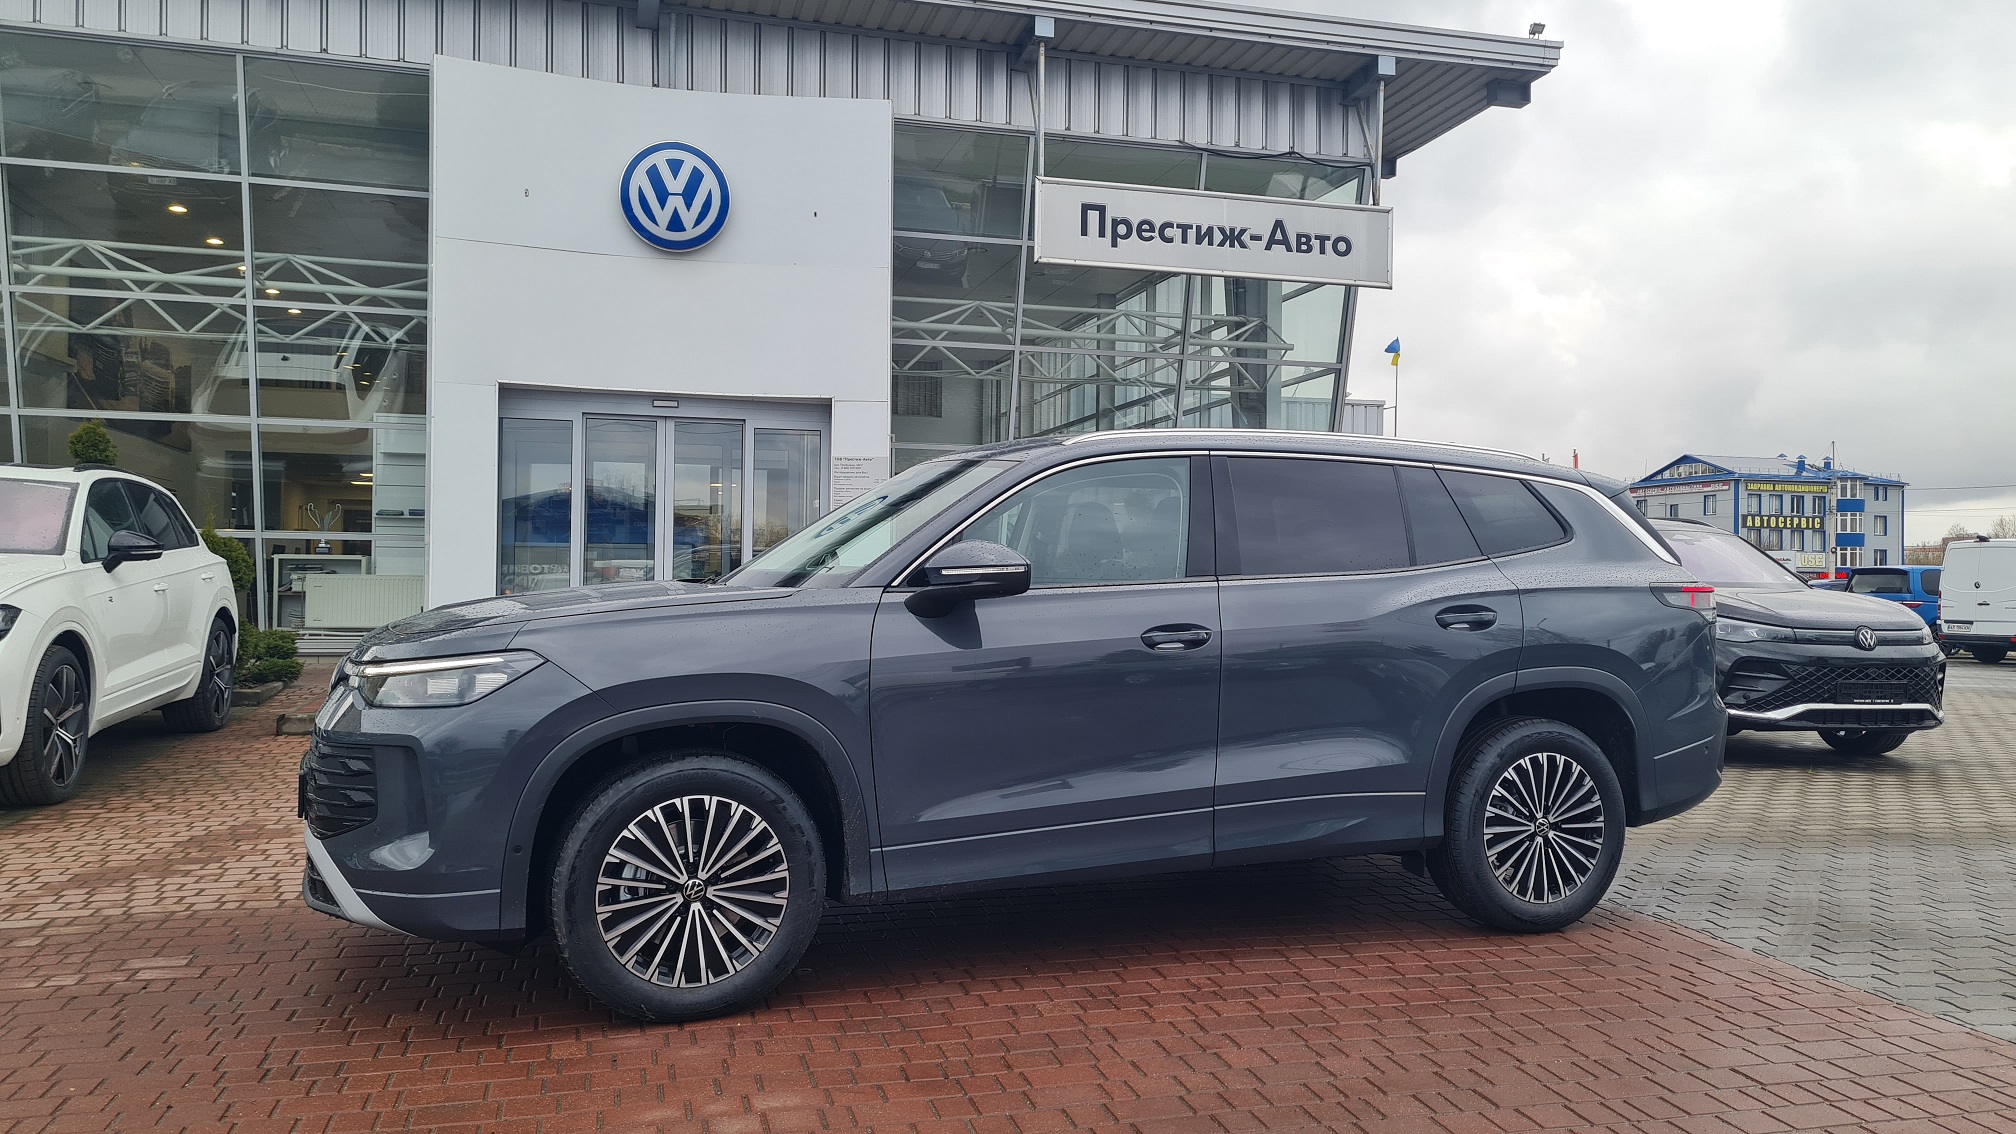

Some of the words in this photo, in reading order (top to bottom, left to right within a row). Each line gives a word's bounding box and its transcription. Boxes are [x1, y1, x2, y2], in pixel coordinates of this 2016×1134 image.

[1080, 203, 1352, 257] Престиж-Авто
[1746, 515, 1821, 529] АВТОСЕРВІС
[1800, 554, 1824, 567] USE
